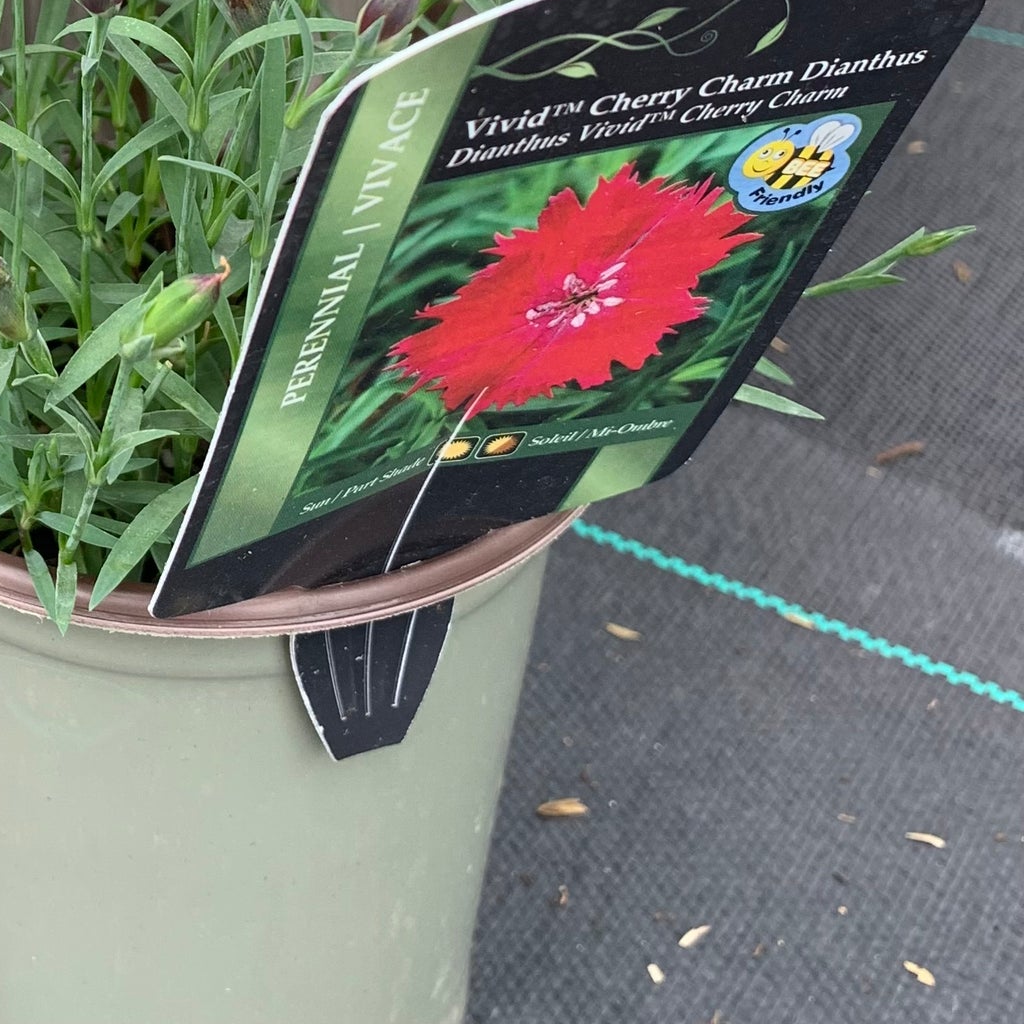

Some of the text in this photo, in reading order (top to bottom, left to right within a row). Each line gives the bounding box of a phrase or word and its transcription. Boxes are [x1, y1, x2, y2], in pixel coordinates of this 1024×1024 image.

[589, 86, 693, 117] Cherry
[698, 70, 794, 97] Charm
[799, 49, 928, 82] Dianthus
[446, 131, 571, 169] Dianthus
[679, 98, 764, 125] Cherry
[768, 85, 850, 110] Charm
[748, 180, 825, 207] Friendly
[787, 158, 826, 177] BEE
[280, 243, 365, 409] PERENNIAL
[352, 87, 430, 215] VIVACE
[528, 431, 576, 447] Soleil
[585, 419, 675, 440] Mi-Ombre
[299, 496, 332, 516] Sun
[342, 477, 379, 499] Part
[378, 457, 426, 483] Shade
